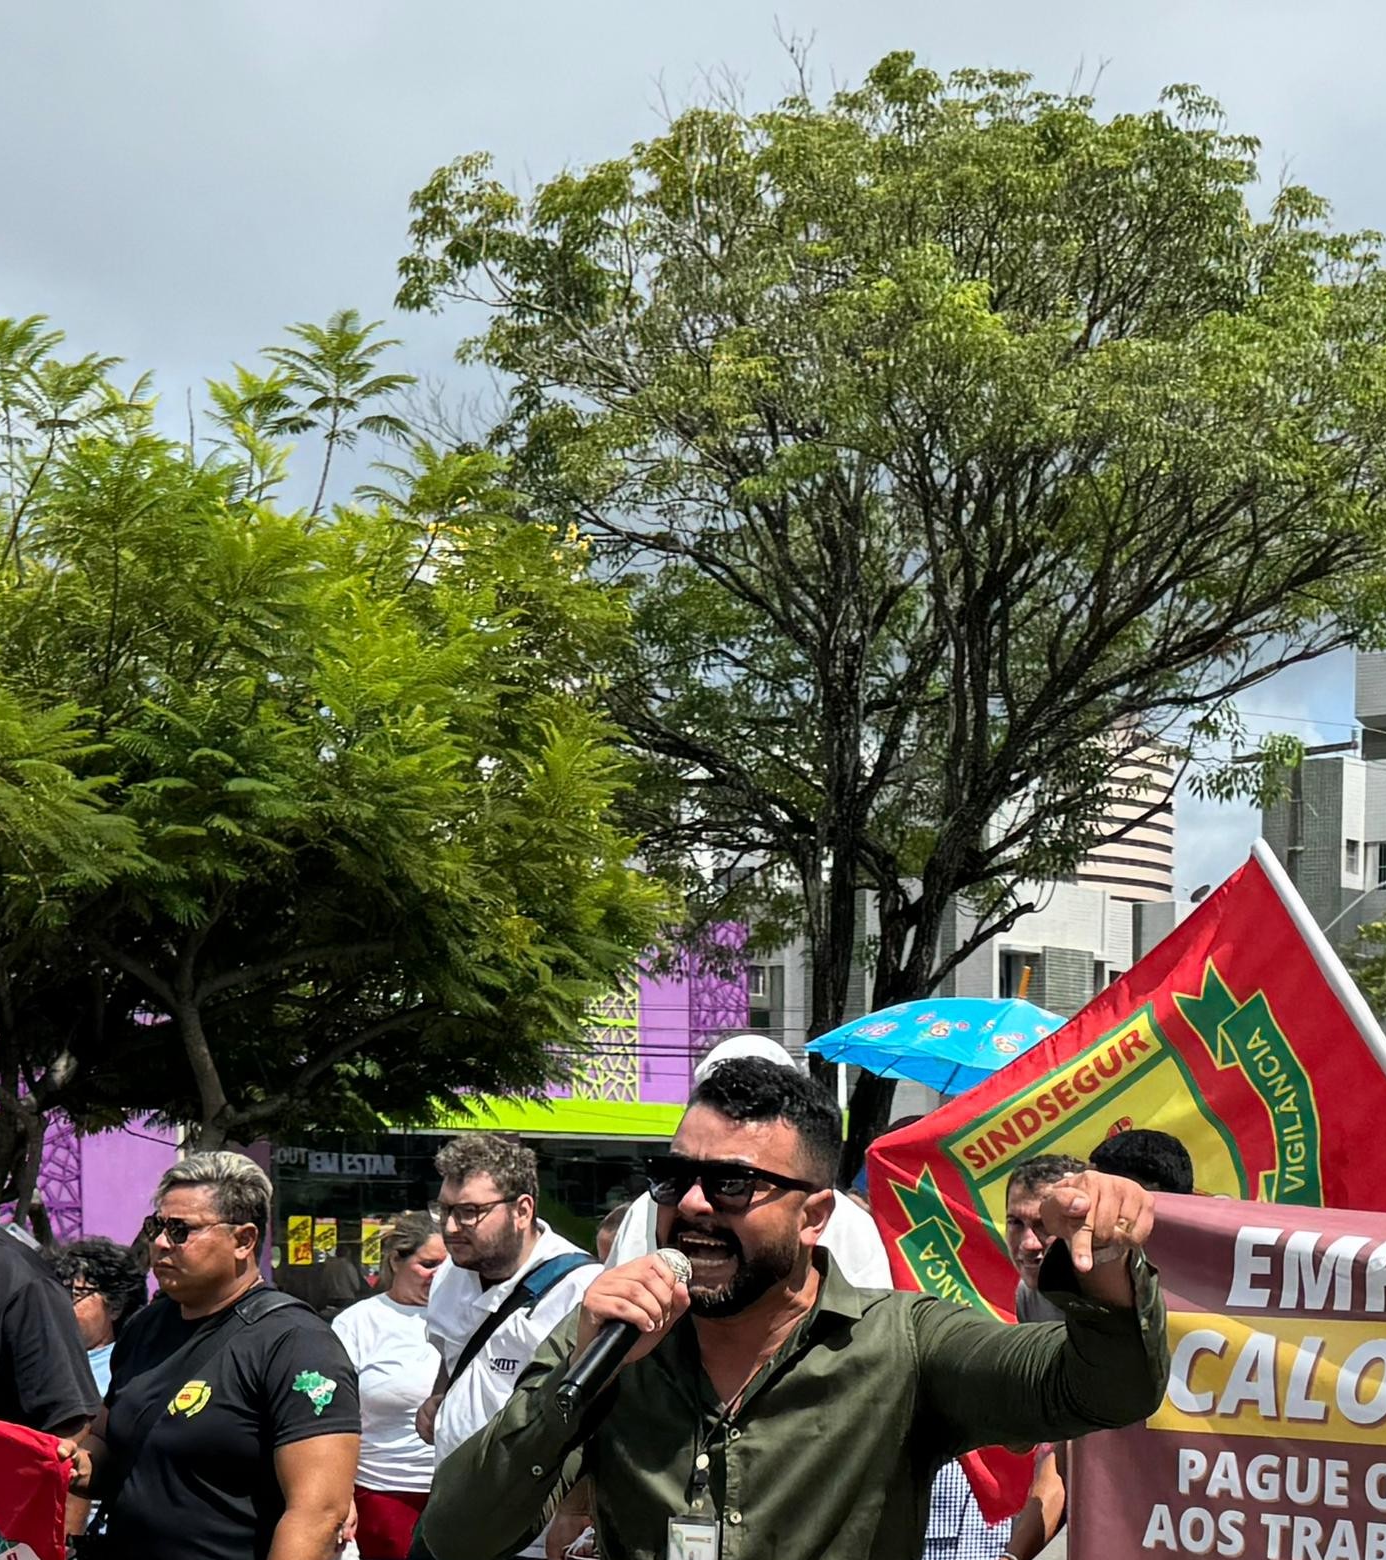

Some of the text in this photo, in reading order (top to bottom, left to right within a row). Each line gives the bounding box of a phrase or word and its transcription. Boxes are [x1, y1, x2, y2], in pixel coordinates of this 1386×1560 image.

[962, 1029, 1151, 1170] SINDSEGUR
[1246, 1026, 1306, 1194] VIGILÂNCIA
[918, 1241, 973, 1308] ANÇA
[1178, 1448, 1350, 1509] PAGUE
[1142, 1504, 1247, 1557] AOS
